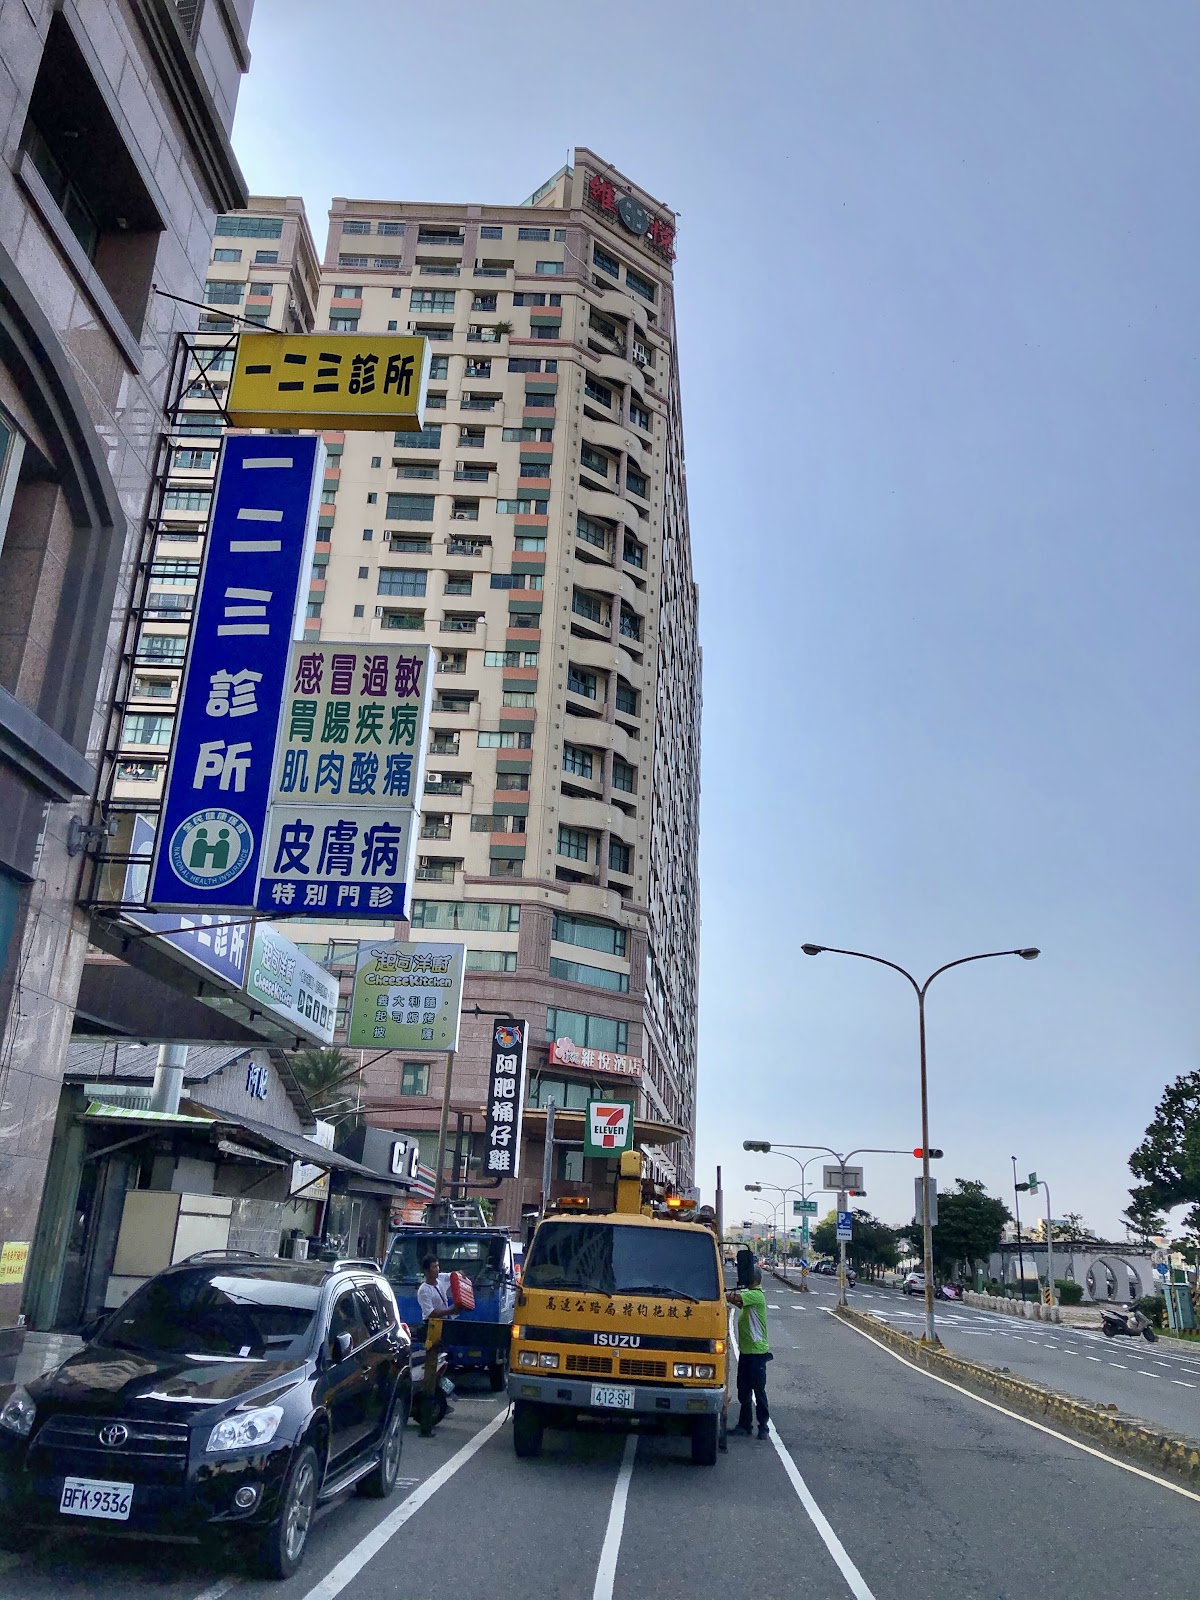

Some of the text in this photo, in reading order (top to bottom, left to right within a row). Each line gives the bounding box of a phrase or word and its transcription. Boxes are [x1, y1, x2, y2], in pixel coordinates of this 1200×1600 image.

[244, 353, 415, 396] 一二三診所
[192, 457, 294, 793] 一二三診所
[293, 652, 423, 699] 感冒過敏
[288, 699, 419, 747] 胃腸疾病
[279, 749, 414, 797] 肌肉酸痛
[173, 846, 249, 886] NATIONAL HEALTH INSURANCE
[273, 818, 402, 877] 皮膚病
[272, 883, 394, 908] 特別門診
[370, 949, 453, 974] 起司洋廚
[377, 994, 437, 1009] 義大利麵
[487, 1053, 518, 1171] 阿肥桶仔雞
[596, 1107, 624, 1147] 7
[593, 1333, 641, 1348] ISUZU
[595, 1390, 631, 1406] 412-SH
